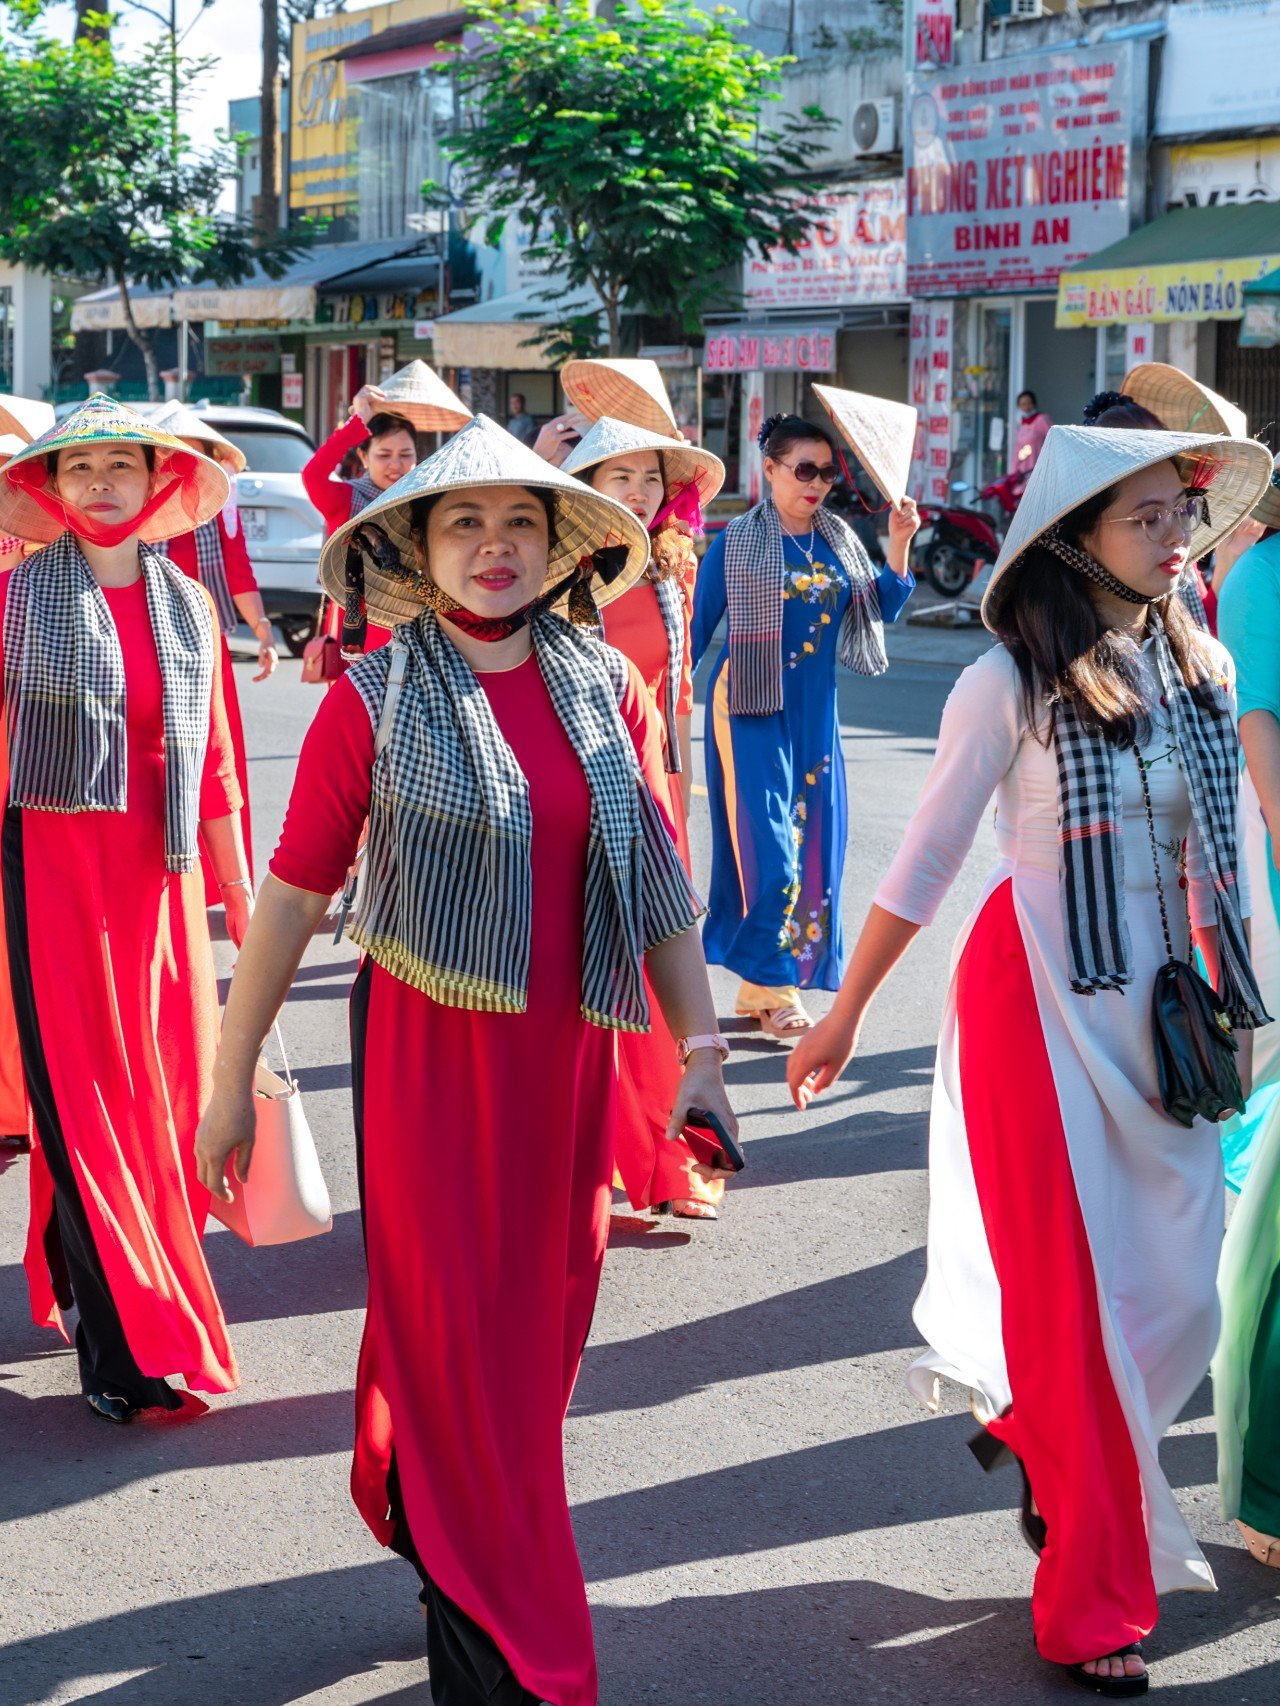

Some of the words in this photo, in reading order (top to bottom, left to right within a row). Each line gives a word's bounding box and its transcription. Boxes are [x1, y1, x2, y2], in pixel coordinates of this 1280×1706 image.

[986, 146, 1027, 210] XÉT
[1031, 135, 1126, 212] NGHIỆM
[855, 208, 907, 244] ÂM
[954, 217, 1021, 252] BÌNH
[1031, 216, 1070, 246] AN
[1166, 276, 1200, 314] NÓN
[1203, 267, 1237, 312] BẢO
